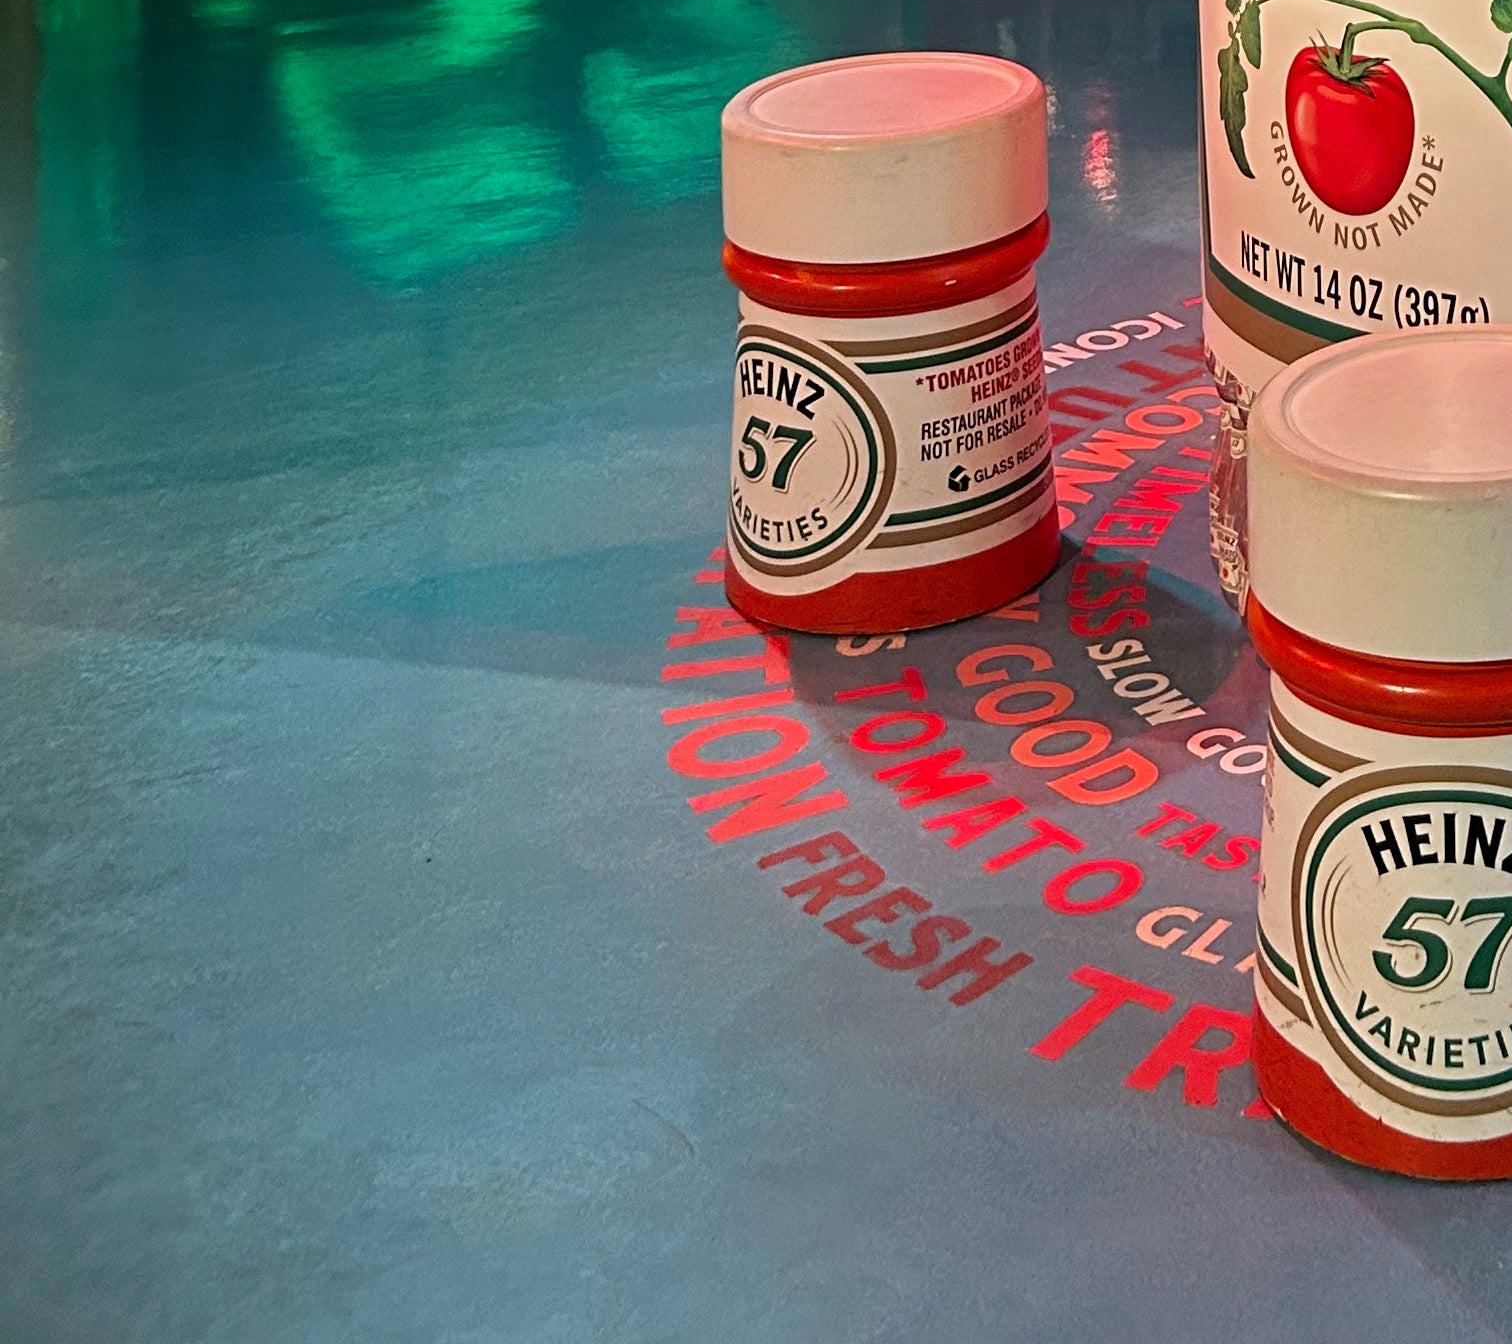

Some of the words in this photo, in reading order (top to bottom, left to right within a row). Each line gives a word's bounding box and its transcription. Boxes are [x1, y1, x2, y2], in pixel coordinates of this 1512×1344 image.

[1269, 120, 1325, 235] GROWN
[1334, 222, 1381, 250] NOT
[1241, 230, 1270, 282] NET
[1275, 248, 1305, 297] WT
[1313, 264, 1342, 310] 14
[1350, 274, 1384, 321] OZ
[741, 359, 825, 420] HEINZ
[921, 398, 1008, 441] RESTAURANT
[739, 416, 816, 494] 57
[921, 438, 952, 462] NOT
[956, 430, 984, 454] FOR
[987, 411, 1027, 444] RESALE
[973, 455, 1015, 483] GLASS
[734, 477, 829, 543] VARIETIES
[956, 623, 1160, 805] GOOD
[1086, 638, 1206, 727] SLOW
[834, 665, 1144, 916] TOMATO
[757, 829, 1034, 1006] FRESH
